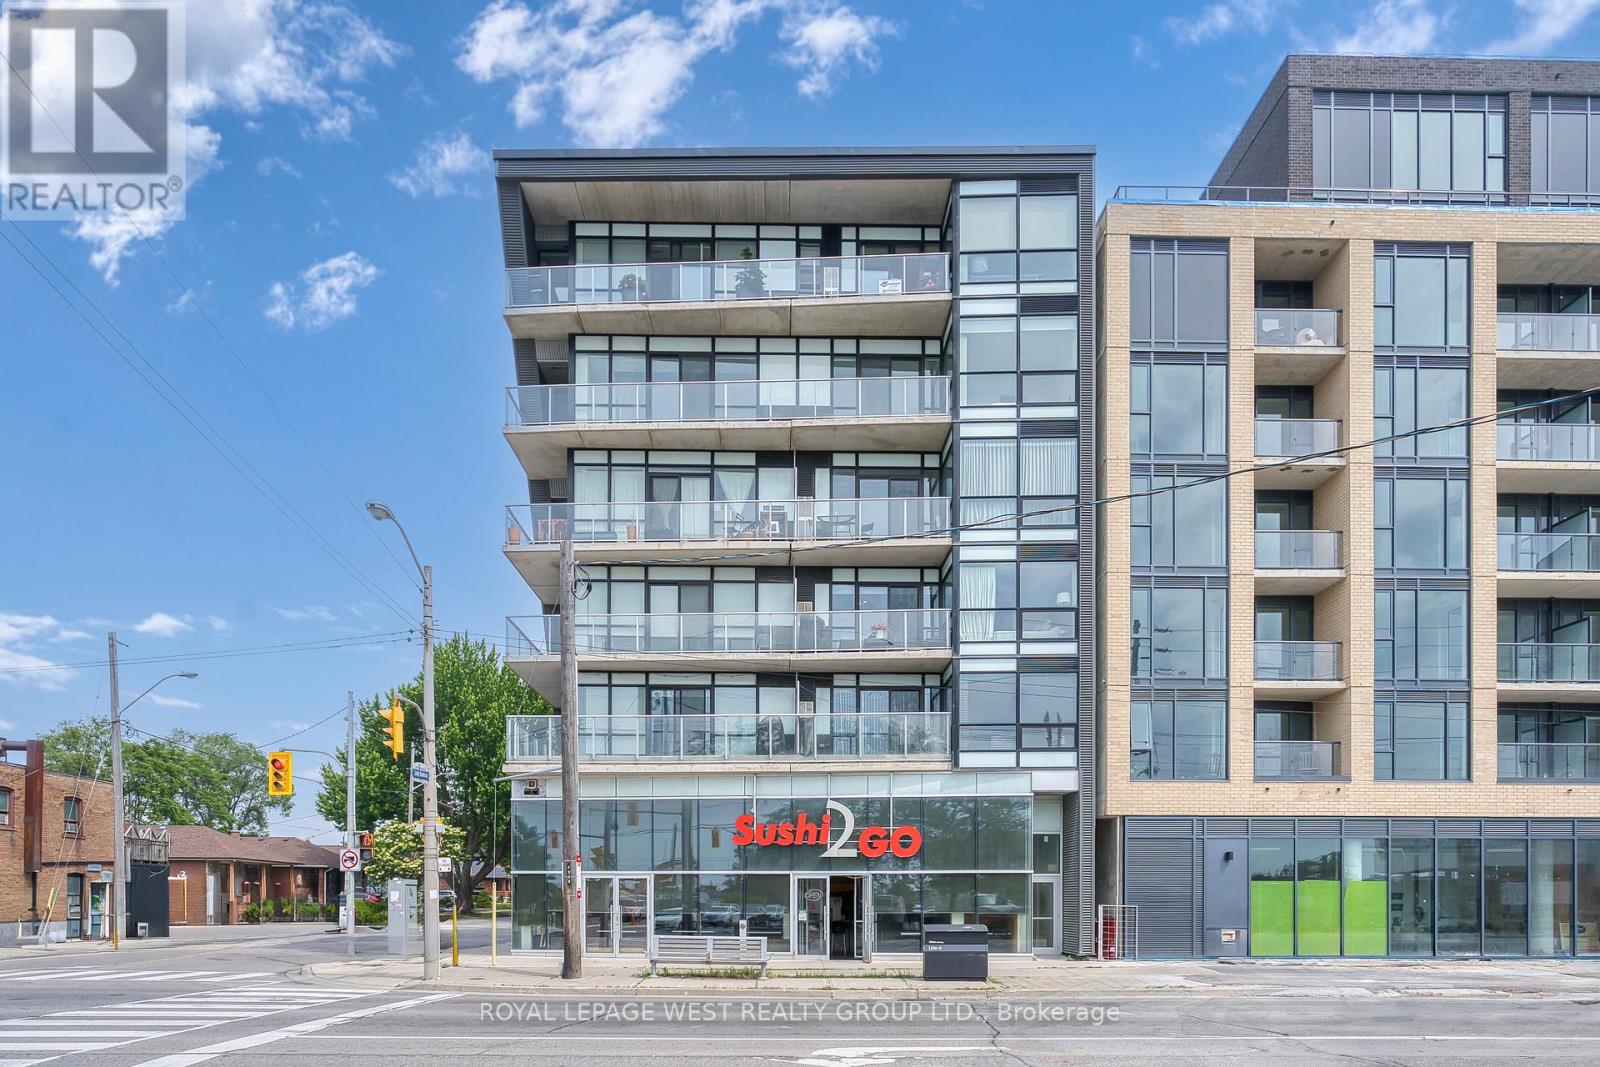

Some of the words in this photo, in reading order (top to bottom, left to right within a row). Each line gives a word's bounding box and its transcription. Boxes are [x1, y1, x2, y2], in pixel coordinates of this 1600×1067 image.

[732, 811, 831, 846] Sushi
[819, 799, 858, 858] 2
[858, 825, 923, 858] GO
